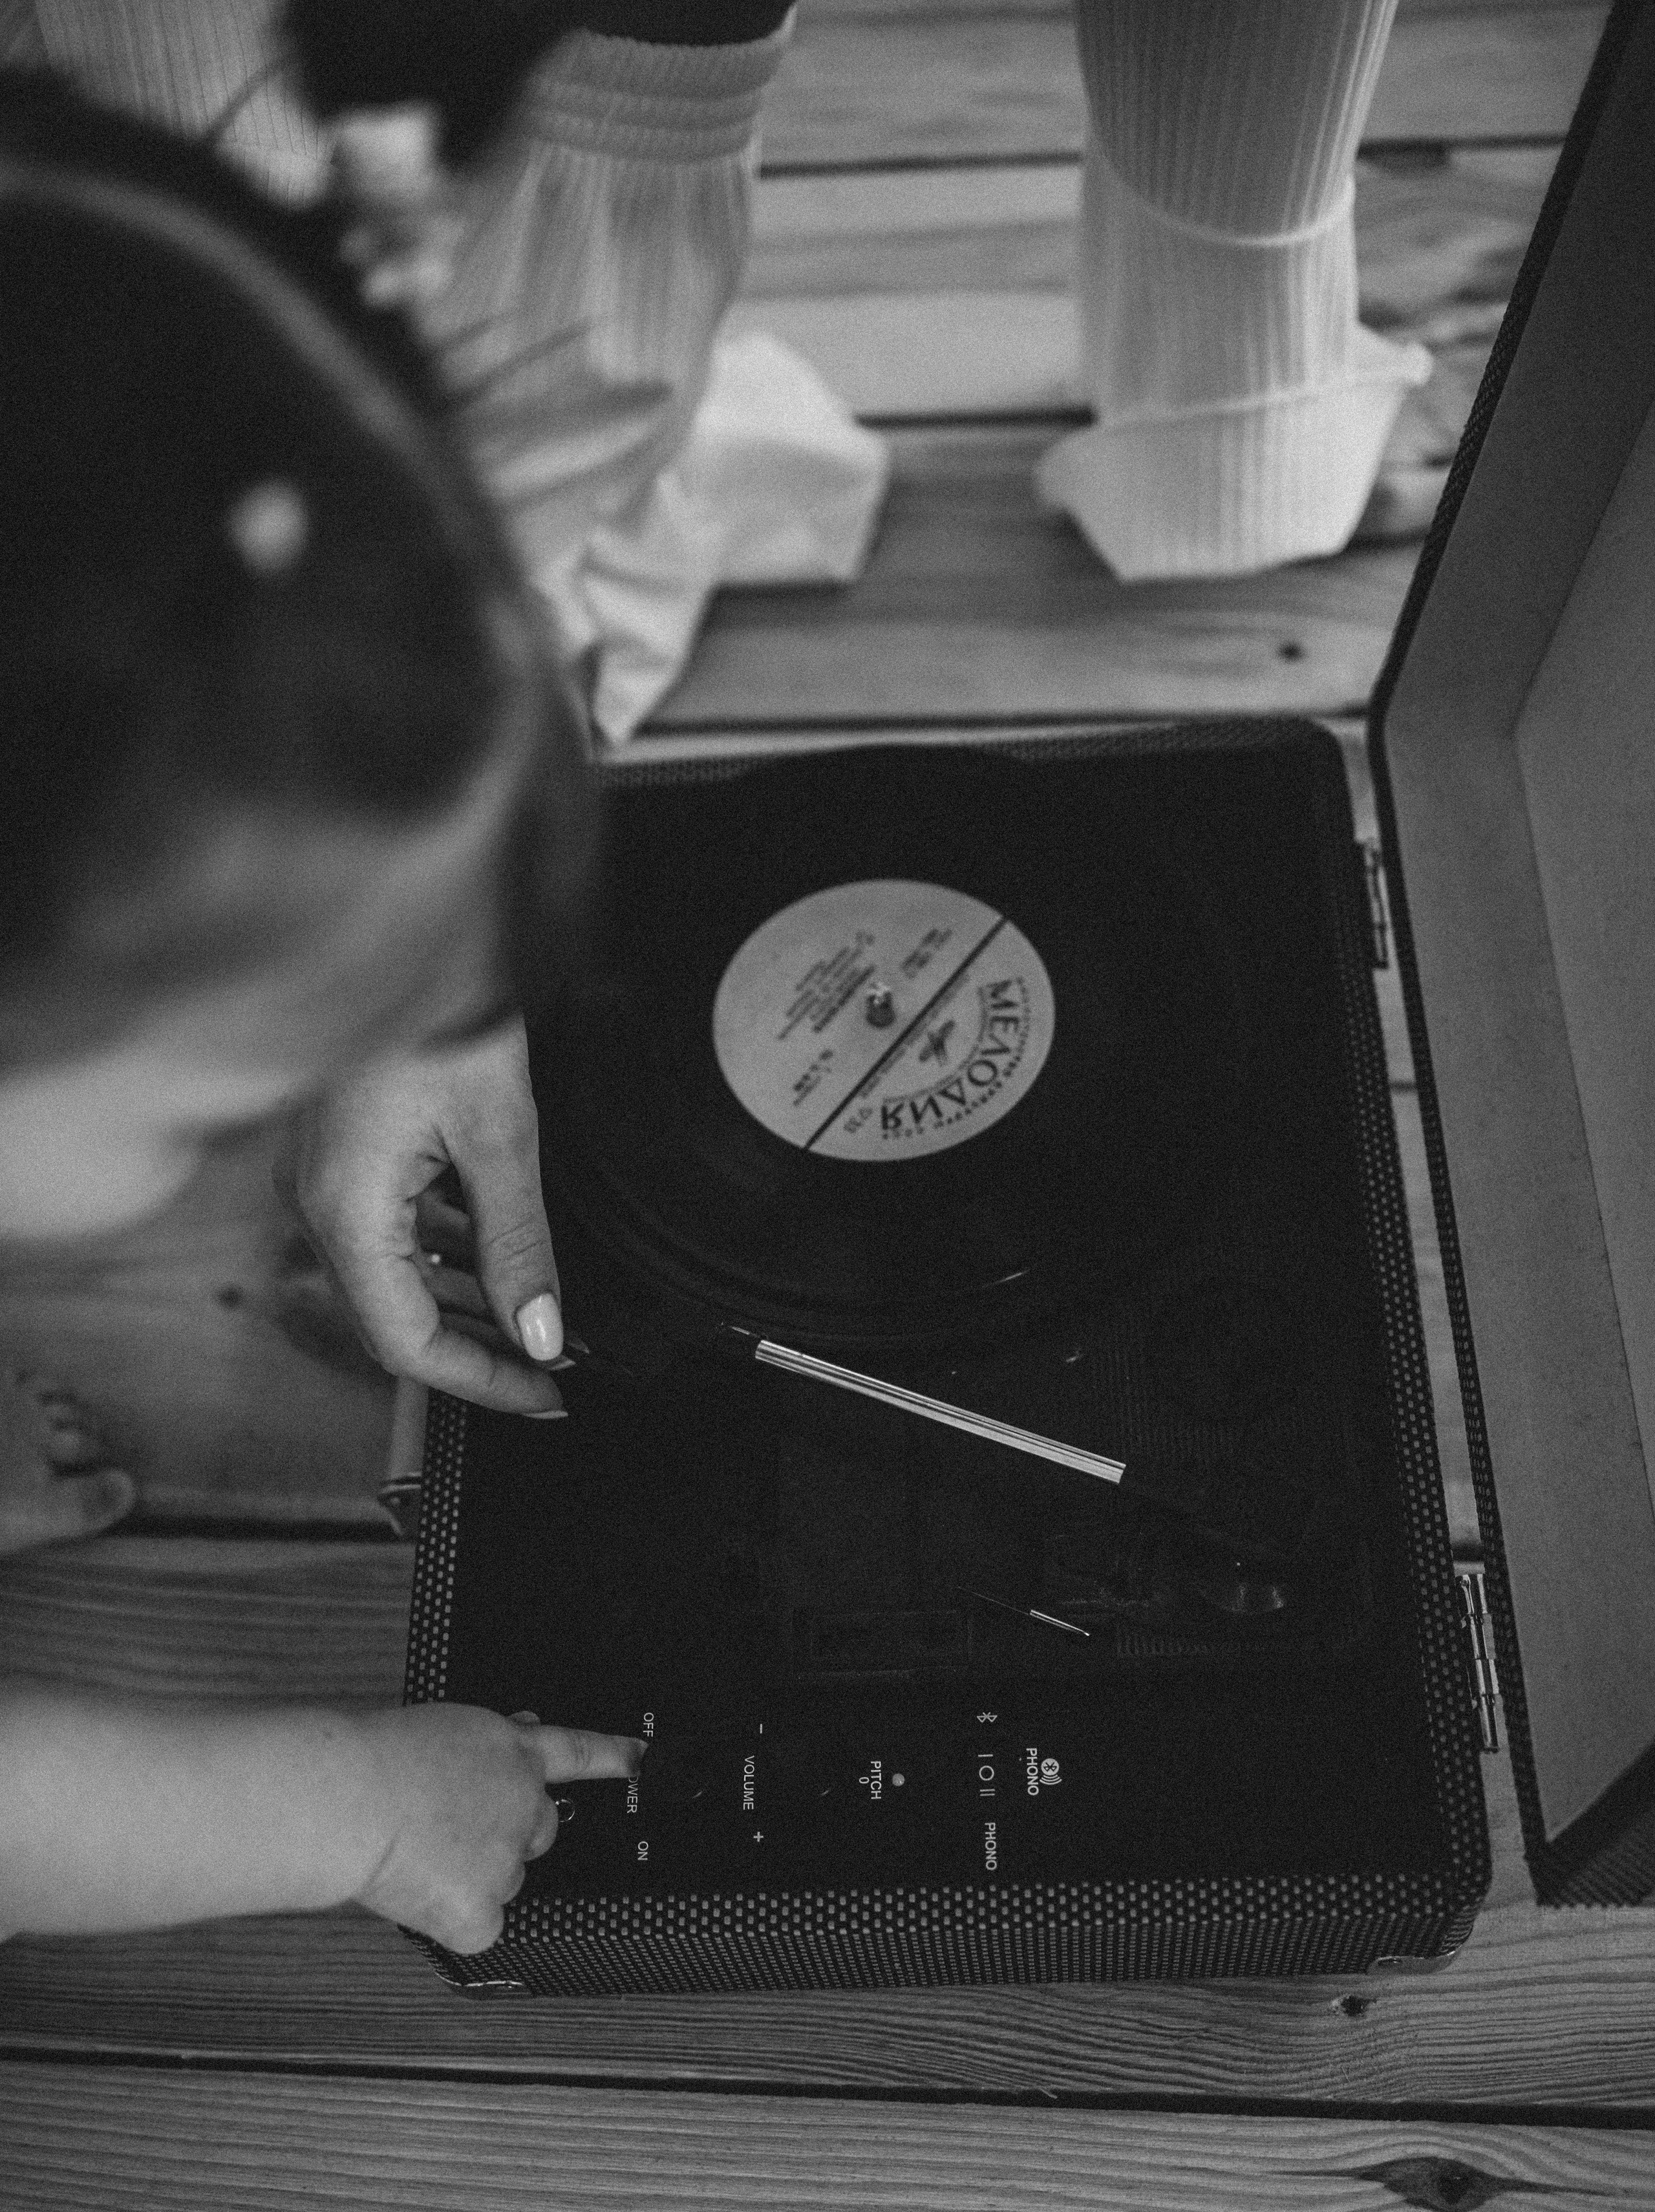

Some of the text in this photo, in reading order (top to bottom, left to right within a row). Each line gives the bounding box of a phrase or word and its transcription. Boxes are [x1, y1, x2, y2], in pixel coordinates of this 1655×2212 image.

[880, 978, 1020, 1132] МЕЛОДИЯ
[643, 1712, 655, 1737] OFF
[742, 1755, 755, 1810] VOLUME
[870, 1760, 882, 1800] PITCH
[1026, 1747, 1039, 1796] PHONO
[626, 1775, 639, 1814] OWER
[637, 1840, 649, 1861] ON
[984, 1821, 998, 1871] PHONO
